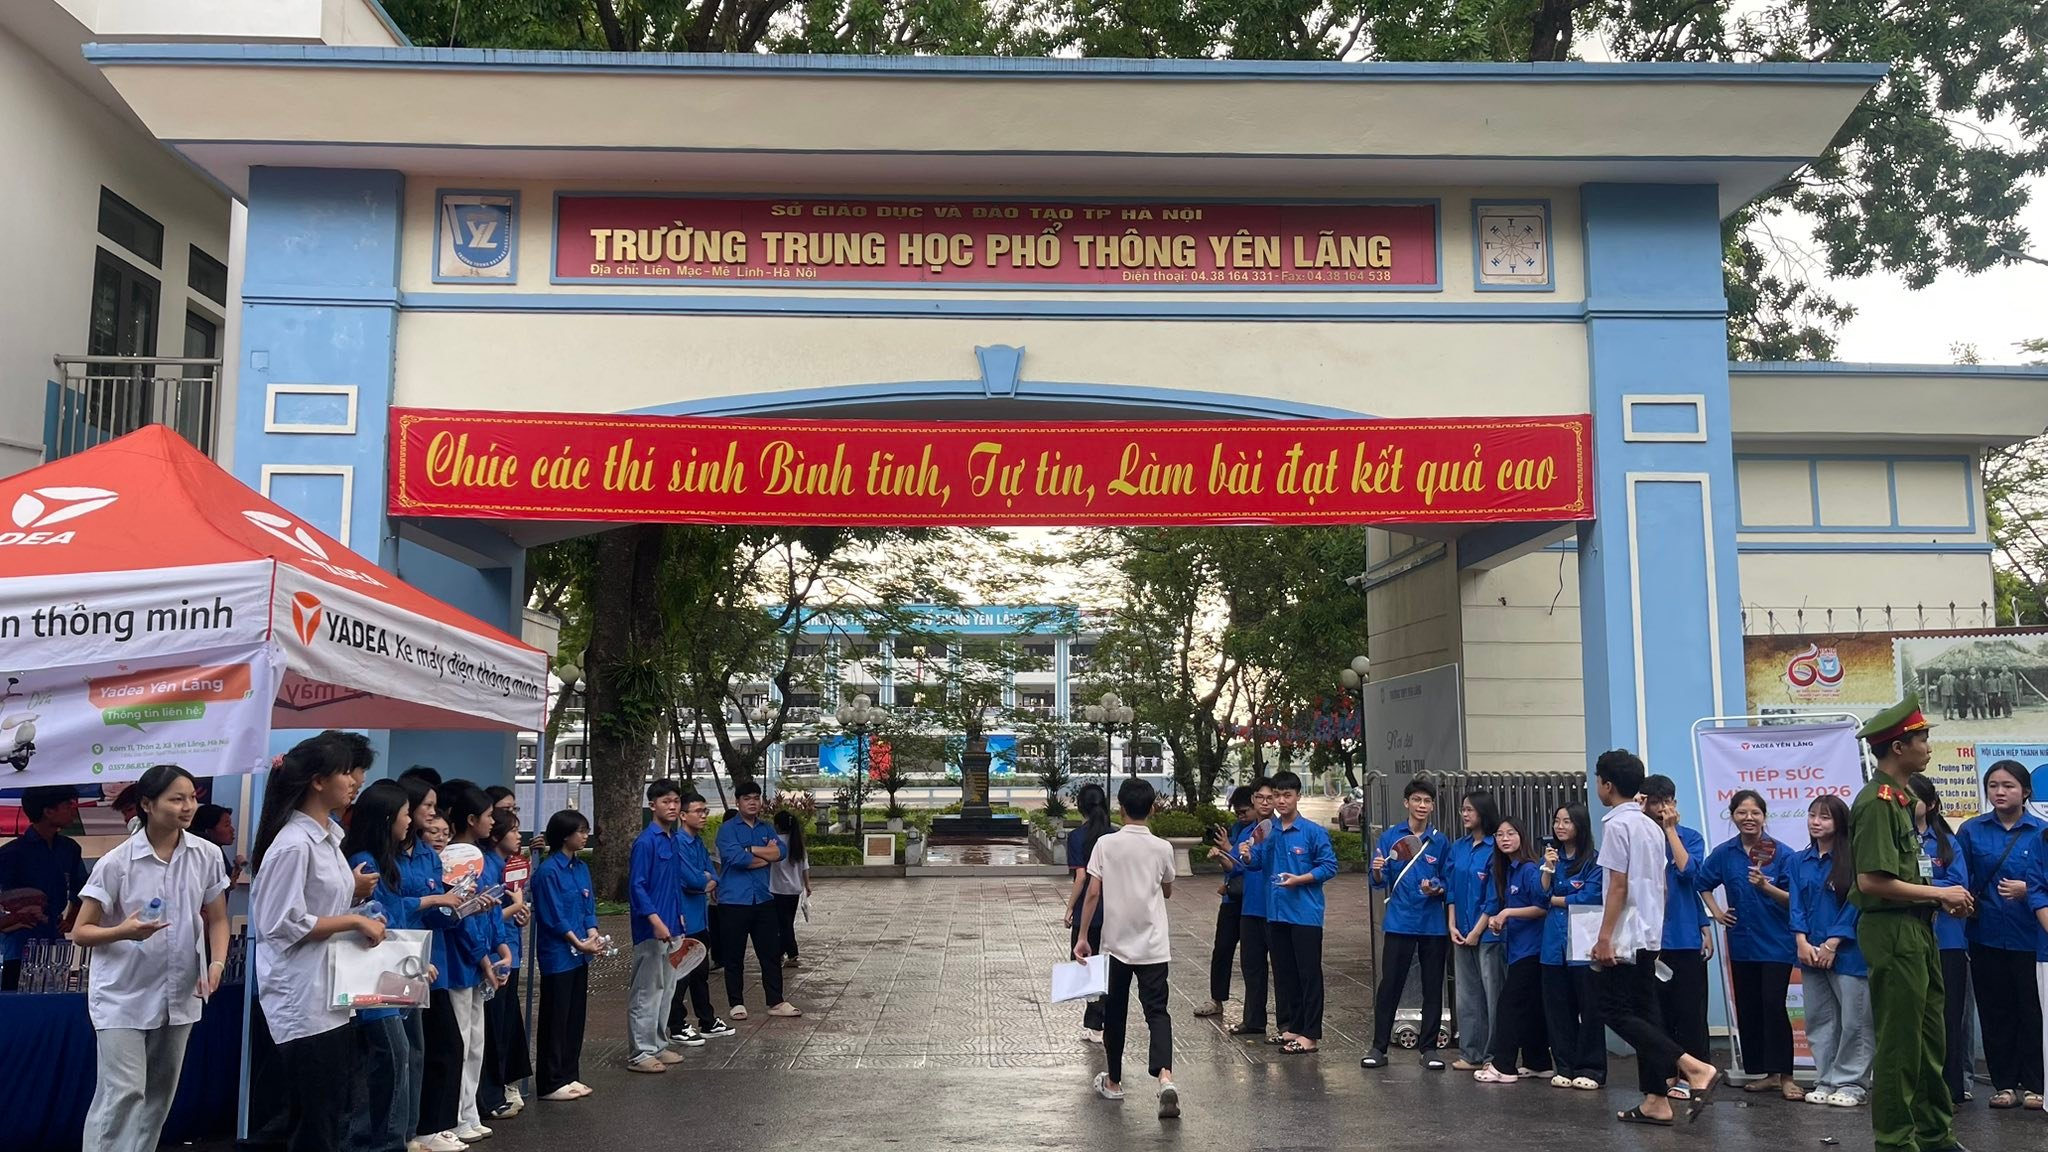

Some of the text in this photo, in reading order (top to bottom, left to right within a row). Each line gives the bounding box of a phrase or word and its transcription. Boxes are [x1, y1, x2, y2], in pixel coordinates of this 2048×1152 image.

[771, 202, 1203, 223] SỞ GIÁO DỤC VÀ ĐÀO TẠO TP HÀ NỘI
[590, 219, 1391, 272] TRƯỜNG TRUNG HỌC PHỔ THÔNG YÊN LÃNG
[590, 263, 611, 277] Địa
[616, 263, 639, 275] chỉ:
[644, 264, 670, 276] Liên
[796, 266, 817, 280] Nội
[1122, 270, 1150, 281] Điện
[1153, 270, 1188, 283] thoại:
[1191, 271, 1224, 281] 04.38
[1228, 271, 1248, 281] 164
[1307, 271, 1341, 281] 04.38
[1344, 271, 1364, 281] 164
[1368, 271, 1391, 281] 538
[426, 431, 1558, 509] Chúc các thí sinh Bình tĩnh, Tự tin, Làm bài đạt kết quả cao
[31, 604, 135, 642] thông
[147, 597, 233, 632] minh
[973, 609, 994, 626] YÊN
[326, 611, 538, 700] YADEA Xe máy điện thông minh
[100, 677, 224, 699] Yadea Yên Lãng
[107, 709, 141, 721] Thông
[144, 706, 160, 718] tin
[162, 706, 183, 717] liên
[1737, 765, 1825, 782] TIẾP SỨC
[1766, 787, 1798, 800] THI
